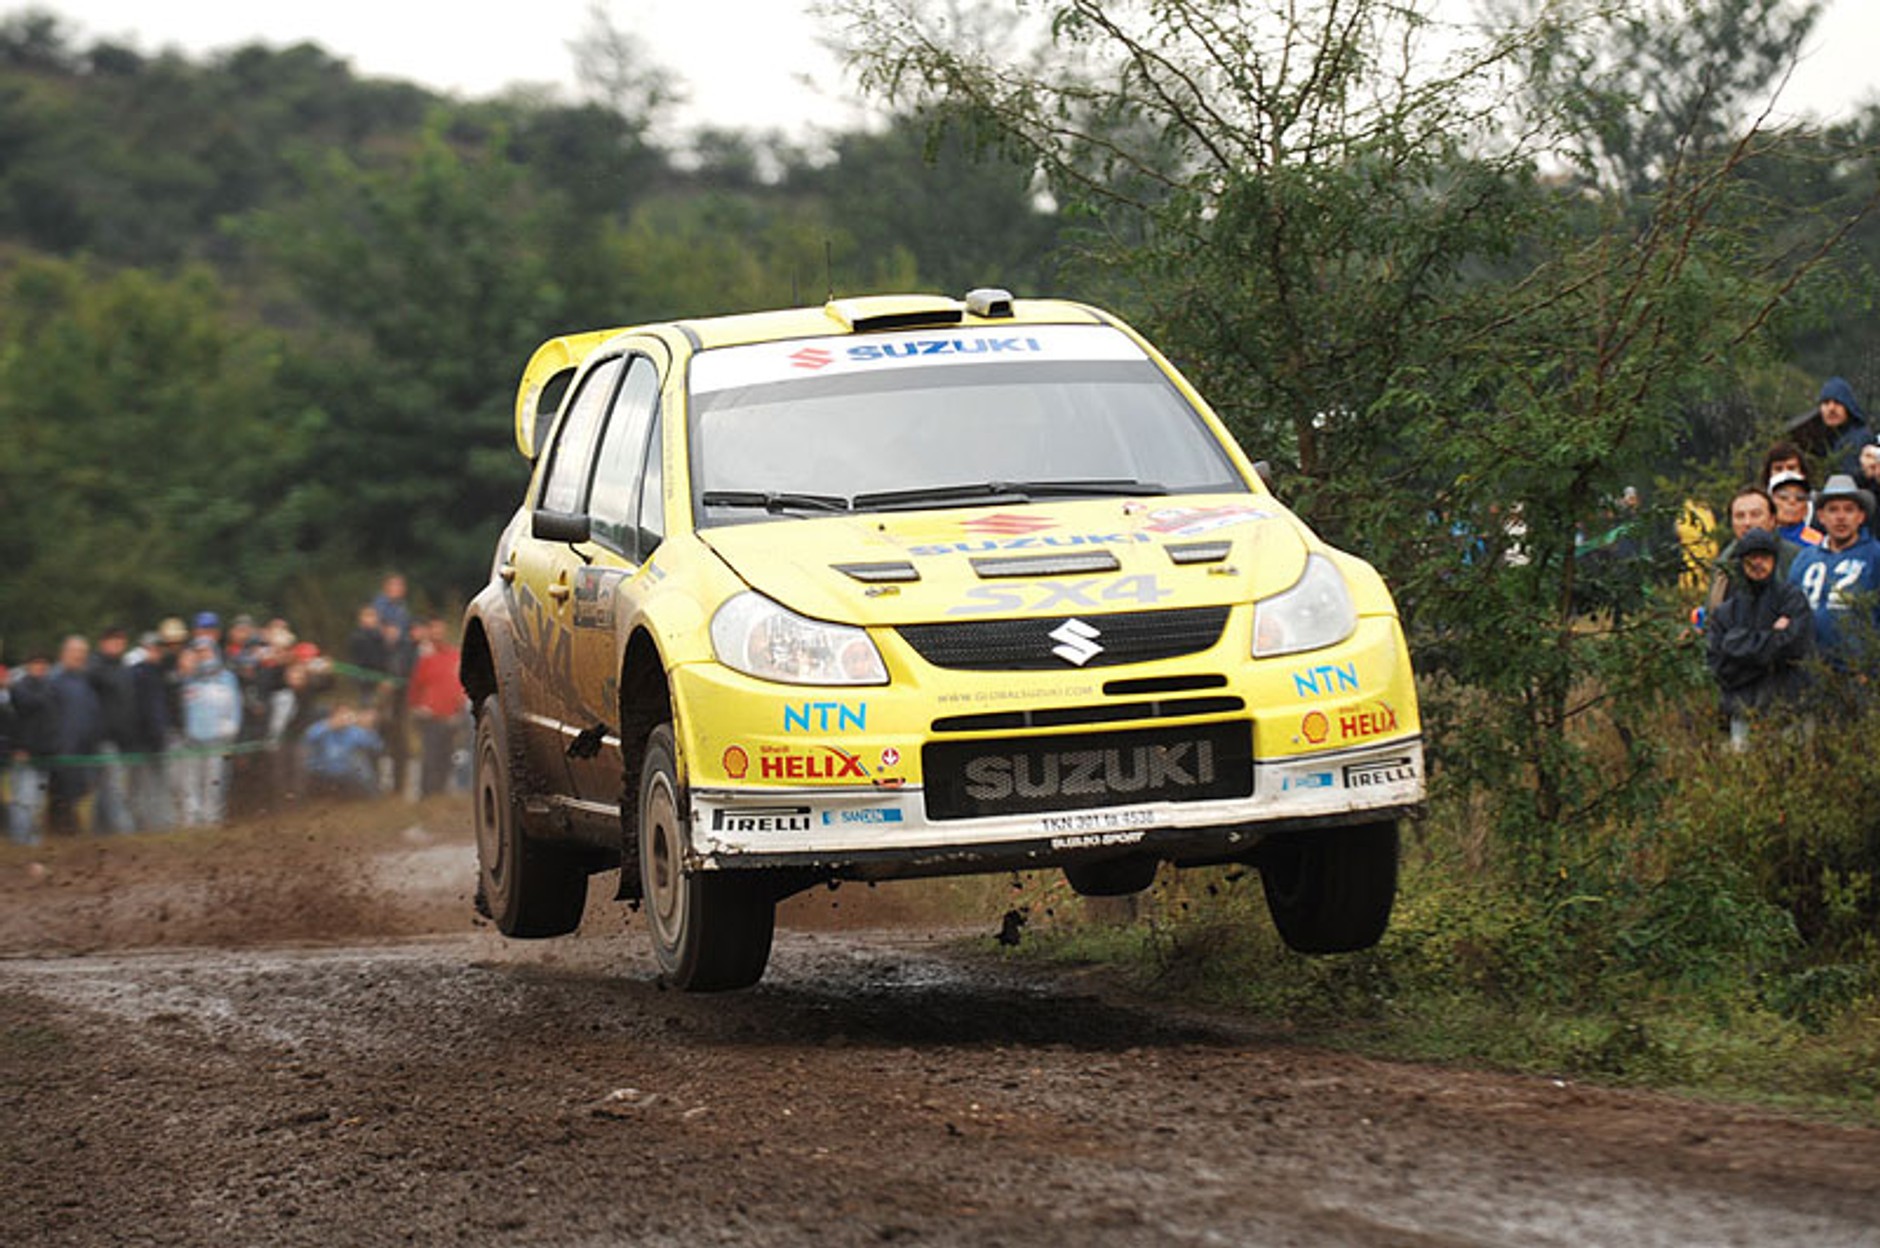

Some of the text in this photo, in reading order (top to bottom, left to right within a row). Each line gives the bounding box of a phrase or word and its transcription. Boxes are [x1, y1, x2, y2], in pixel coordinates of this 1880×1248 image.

[846, 337, 1042, 361] SUZUKI
[908, 533, 1151, 556] SUZUKI
[945, 574, 1173, 615] SX4
[1802, 559, 1867, 610] 92
[1292, 662, 1359, 697] NTN
[784, 702, 867, 732] NTN
[1339, 704, 1398, 739] HELIX
[760, 749, 869, 779] HELIX
[965, 740, 1214, 800] SUZUKI
[1342, 757, 1416, 788] PIRELLI
[712, 806, 811, 831] PIRELLI
